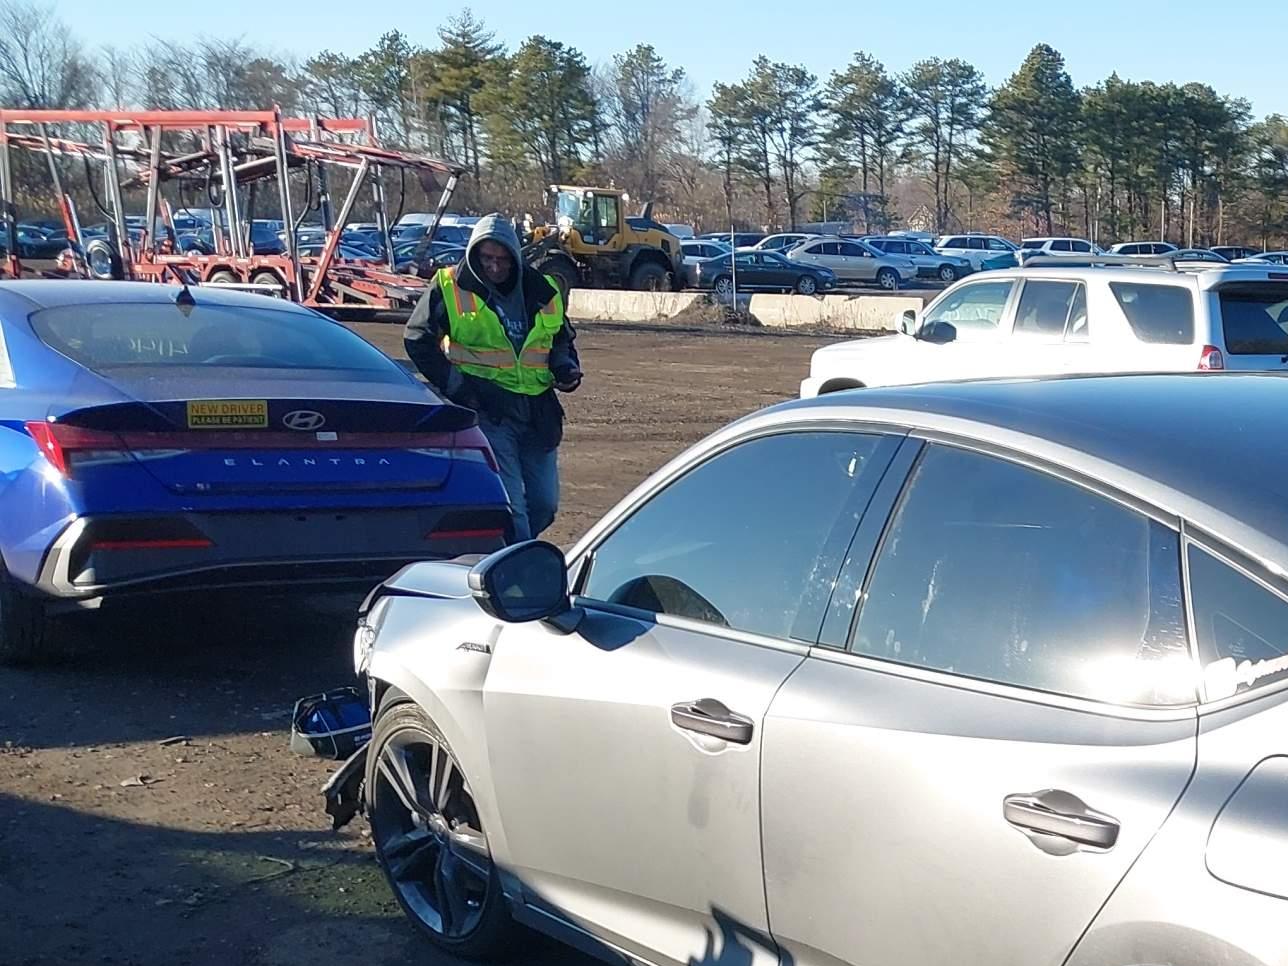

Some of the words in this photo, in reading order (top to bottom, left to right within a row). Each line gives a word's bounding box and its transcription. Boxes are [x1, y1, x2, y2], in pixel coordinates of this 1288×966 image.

[191, 404, 218, 414] NEW
[221, 403, 264, 414] DRIVER
[224, 458, 391, 466] ELANTRA
